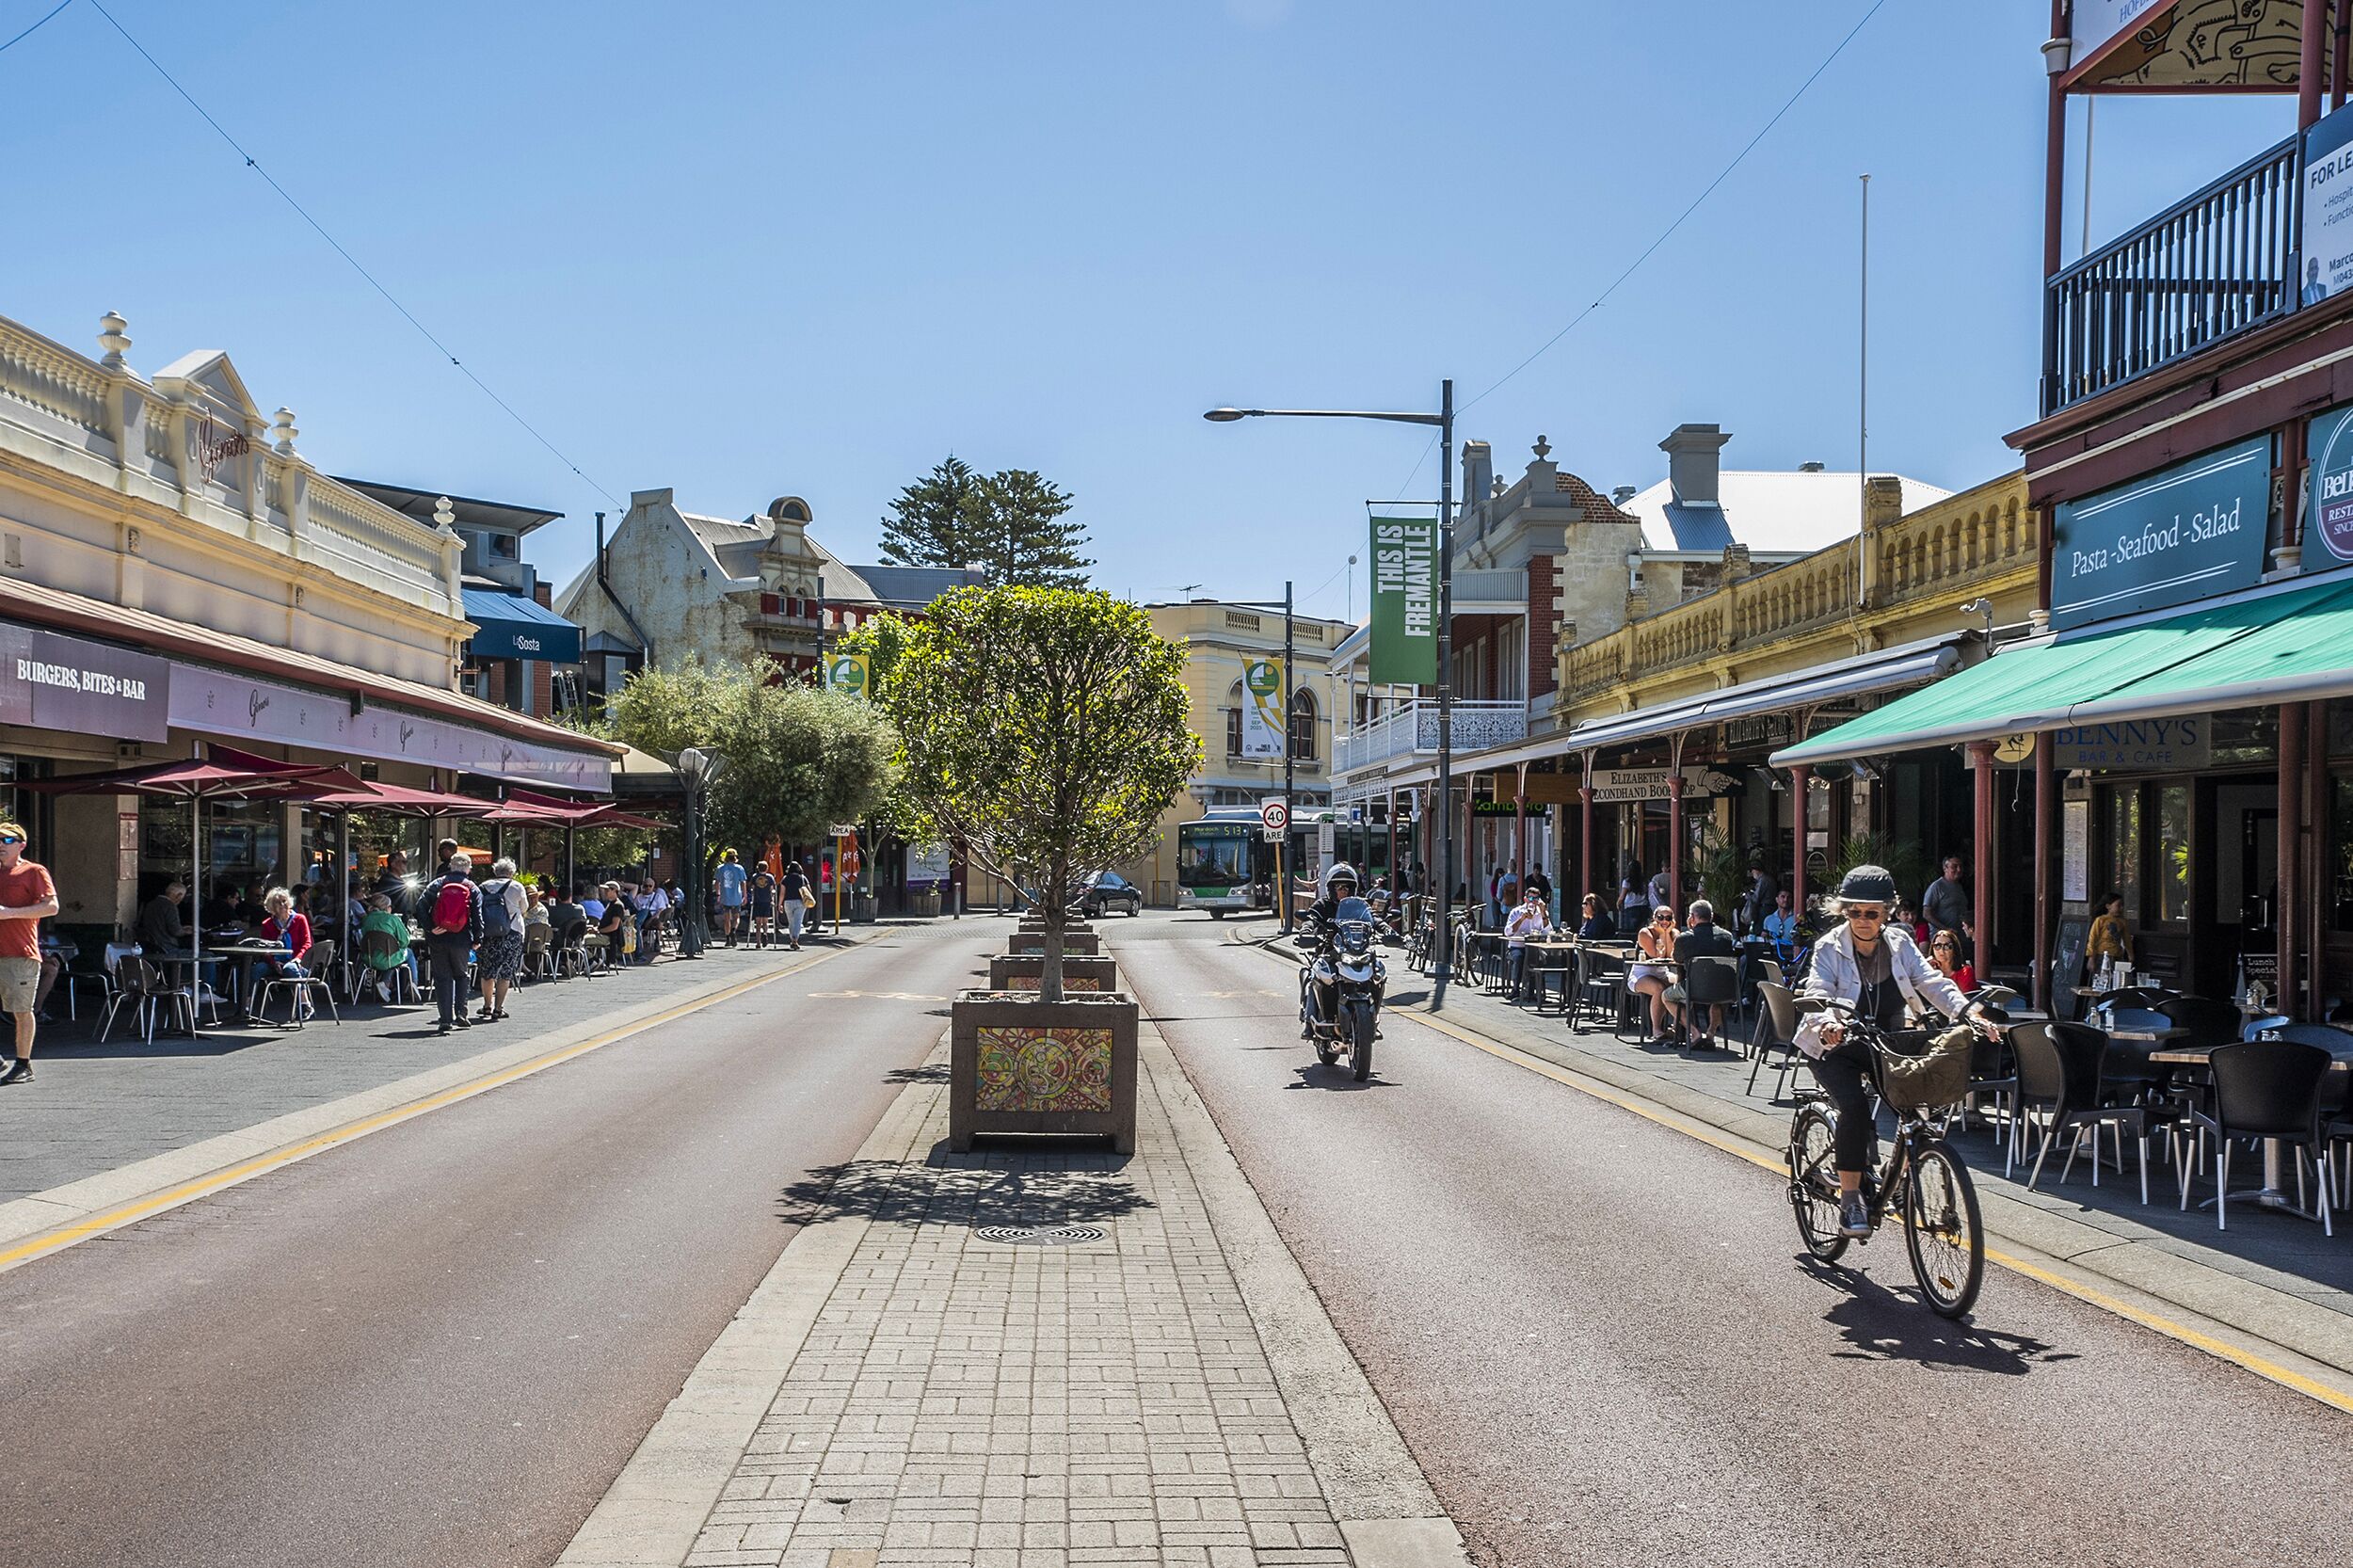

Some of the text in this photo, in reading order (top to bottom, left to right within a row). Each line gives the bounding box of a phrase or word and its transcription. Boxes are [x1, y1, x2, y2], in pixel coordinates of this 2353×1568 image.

[2311, 151, 2353, 189] FOR LE
[2328, 504, 2353, 521] REST
[1377, 525, 1404, 594] THIS IS
[2072, 548, 2107, 578] Pasta
[1404, 525, 1431, 637] FREMANTLE
[17, 659, 146, 700] BURGERS, BITES & BAR
[2055, 718, 2197, 746] BENNY'S
[2078, 749, 2172, 764] BAR & CAFE
[1610, 771, 1667, 785] ELIZABETH'S
[1593, 787, 1647, 800] ECONDHAND
[1267, 810, 1284, 823] 40
